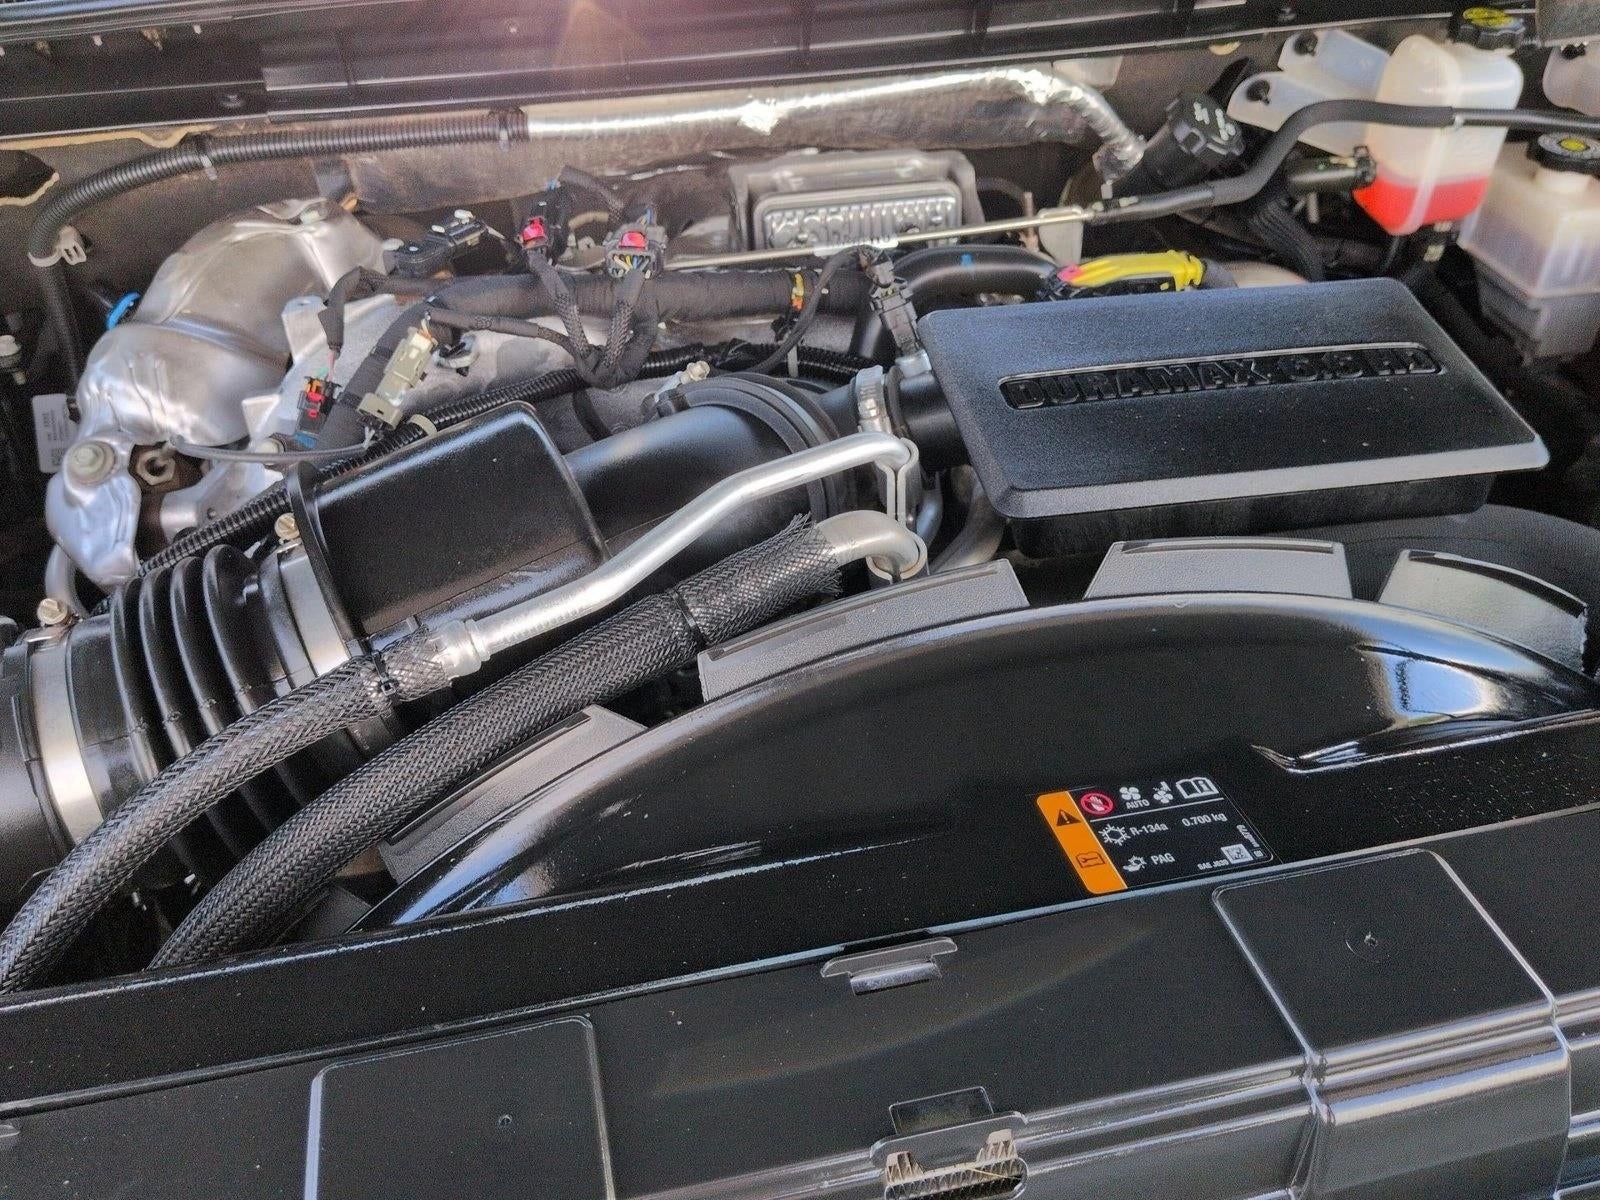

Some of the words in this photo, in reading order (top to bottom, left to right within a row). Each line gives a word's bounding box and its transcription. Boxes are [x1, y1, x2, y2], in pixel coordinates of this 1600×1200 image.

[1004, 359, 1270, 408] DURAMAX
[1126, 799, 1150, 809] AUTO
[1130, 823, 1169, 837] R-134a
[1182, 814, 1211, 827] 0.700
[1213, 812, 1228, 823] kg
[1151, 853, 1176, 865] PAG
